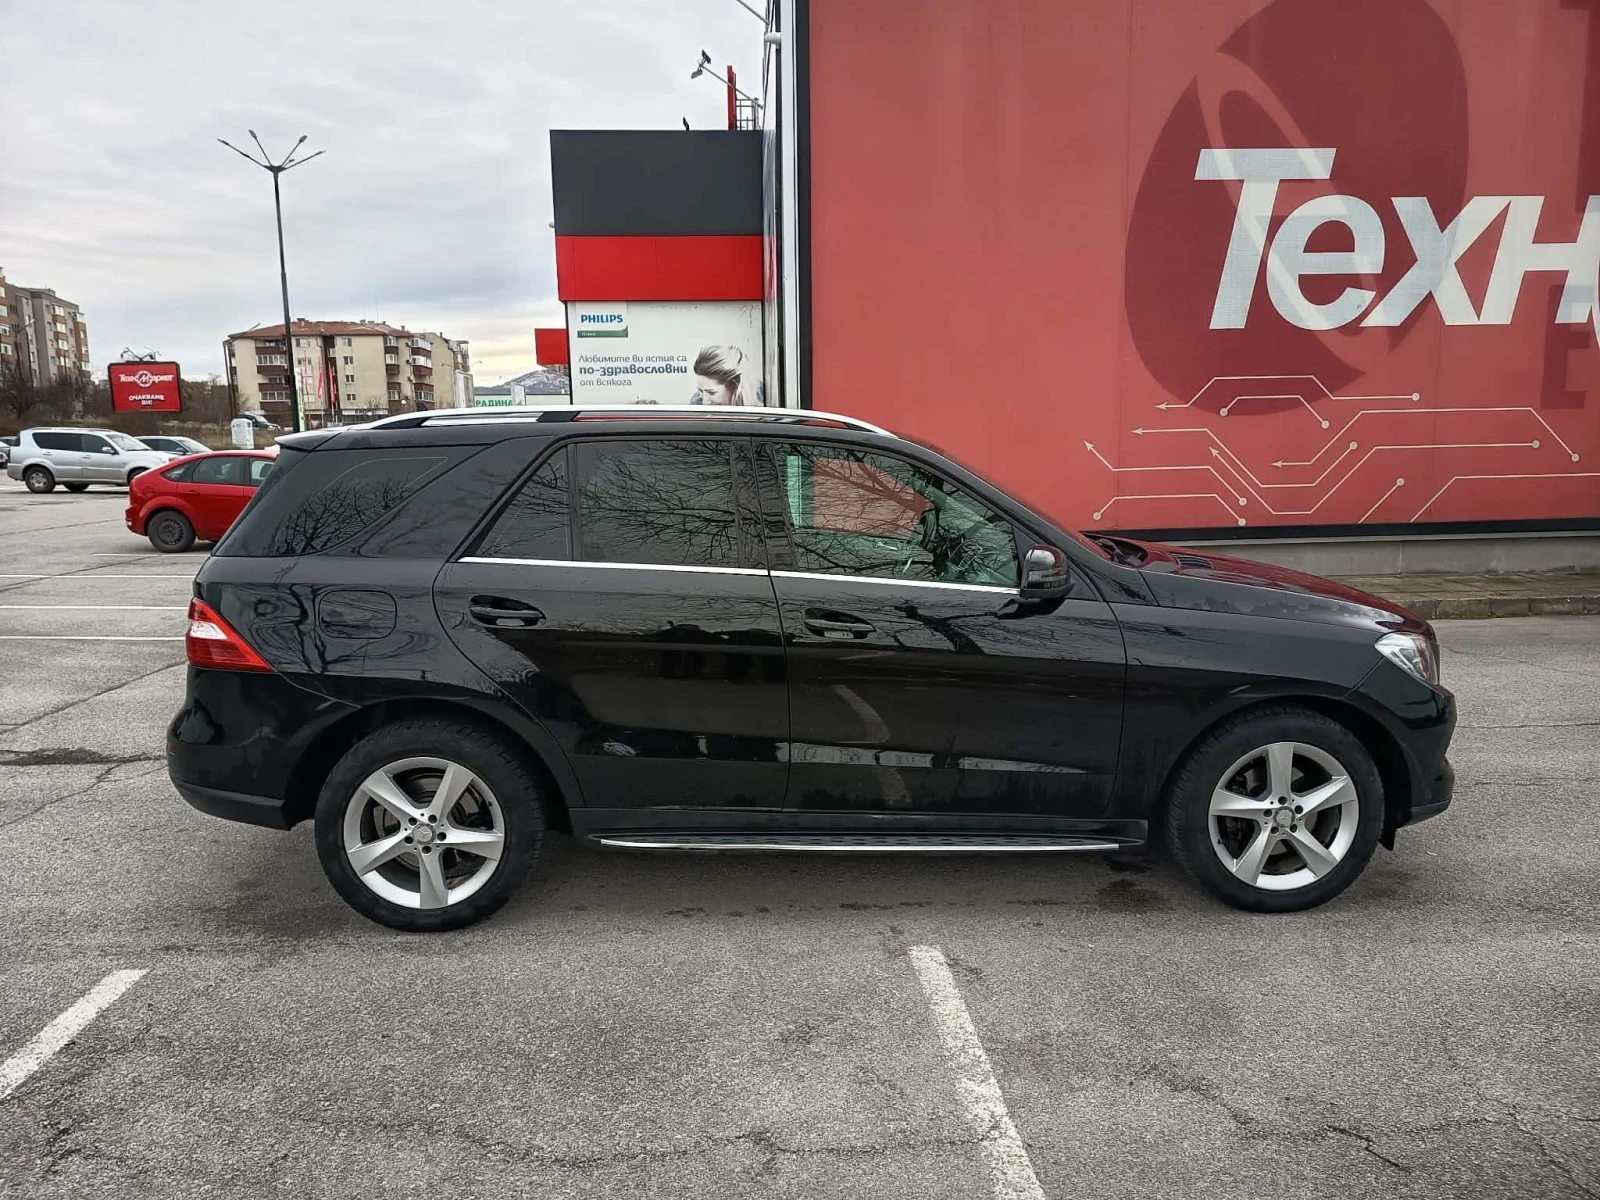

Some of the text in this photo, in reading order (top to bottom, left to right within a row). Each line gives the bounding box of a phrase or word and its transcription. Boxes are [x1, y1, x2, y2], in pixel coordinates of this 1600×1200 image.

[1194, 147, 1600, 335] Техн
[580, 314, 624, 323] PHILIPS
[579, 354, 631, 363] Любимите
[632, 354, 644, 362] ви
[579, 363, 688, 376] по-здравословни
